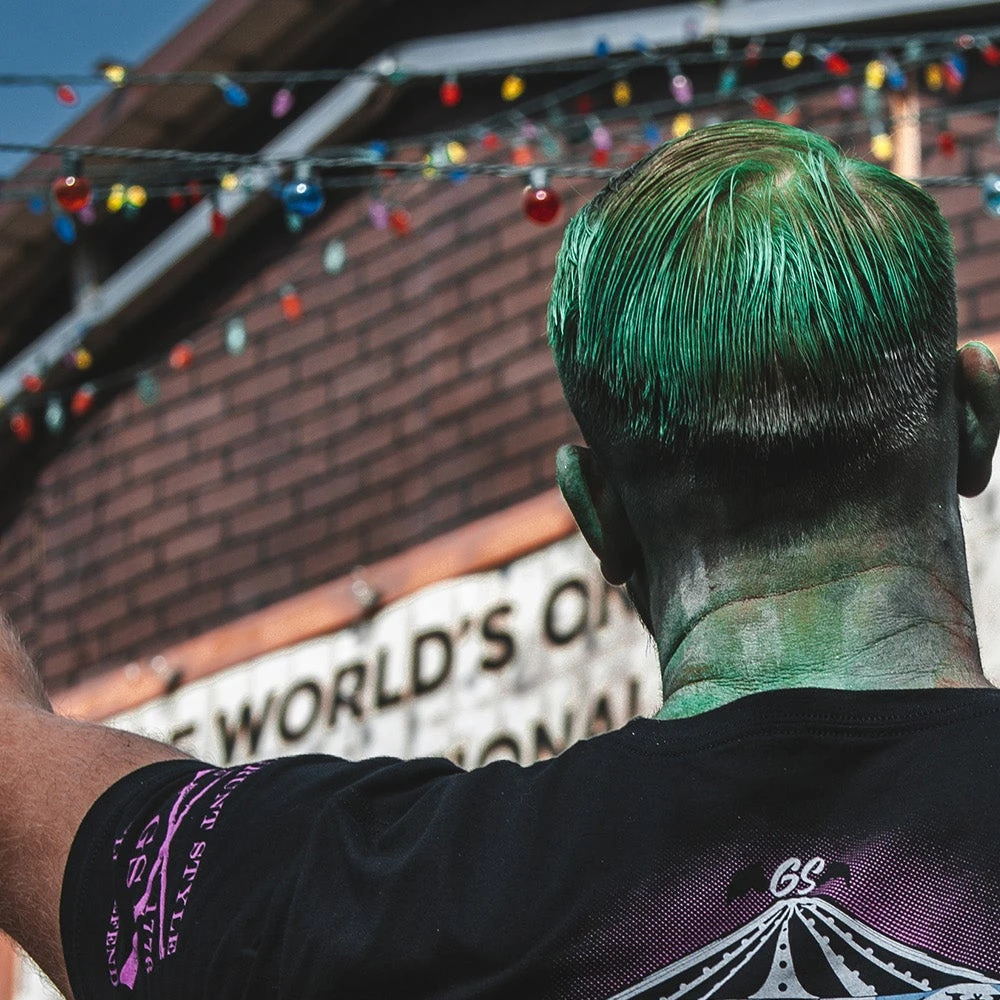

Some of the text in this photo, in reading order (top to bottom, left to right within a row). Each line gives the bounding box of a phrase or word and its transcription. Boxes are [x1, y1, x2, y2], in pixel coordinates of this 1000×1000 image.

[216, 604, 516, 766] WORLD'S
[127, 815, 160, 888] GS
[769, 856, 825, 898] GS
[167, 841, 206, 955] STYLE
[143, 902, 157, 974] 1776
